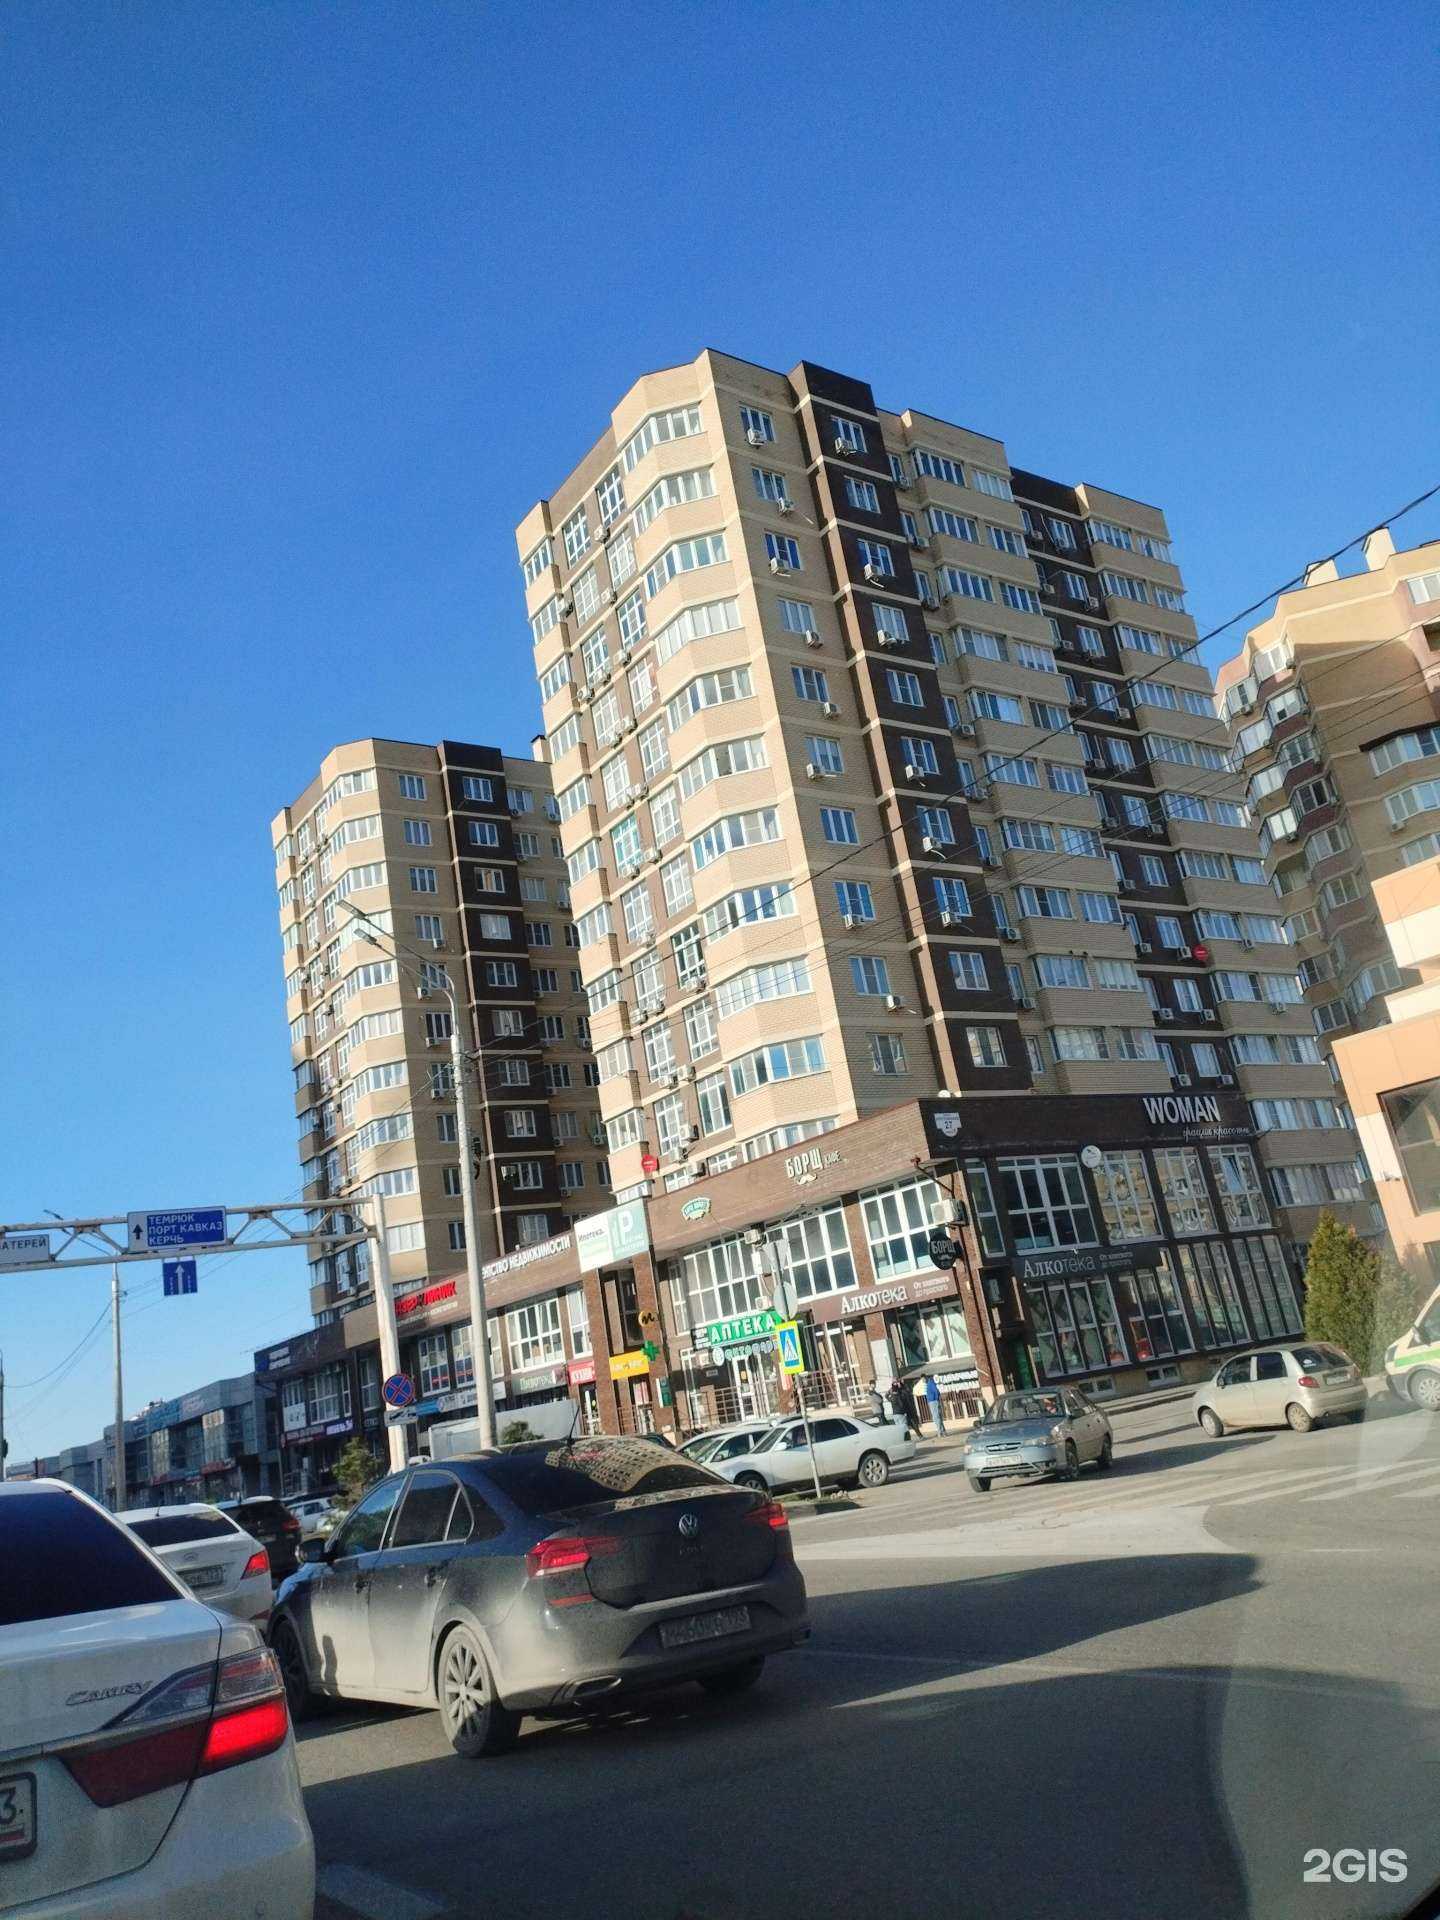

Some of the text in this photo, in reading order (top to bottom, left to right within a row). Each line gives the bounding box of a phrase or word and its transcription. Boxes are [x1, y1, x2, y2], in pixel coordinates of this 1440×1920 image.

[1142, 1096, 1222, 1124] WOMAN
[784, 1148, 824, 1178] БОРЩ
[149, 1213, 195, 1226] ТЕМРЮК
[149, 1221, 224, 1236] ПОРТ КАВКАЗ
[0, 1236, 47, 1250] АТЕРЕЙ
[149, 1235, 184, 1244] КЕРЧЬ
[930, 1240, 956, 1254] БОРЩ
[711, 1313, 776, 1343] АПТЕКА
